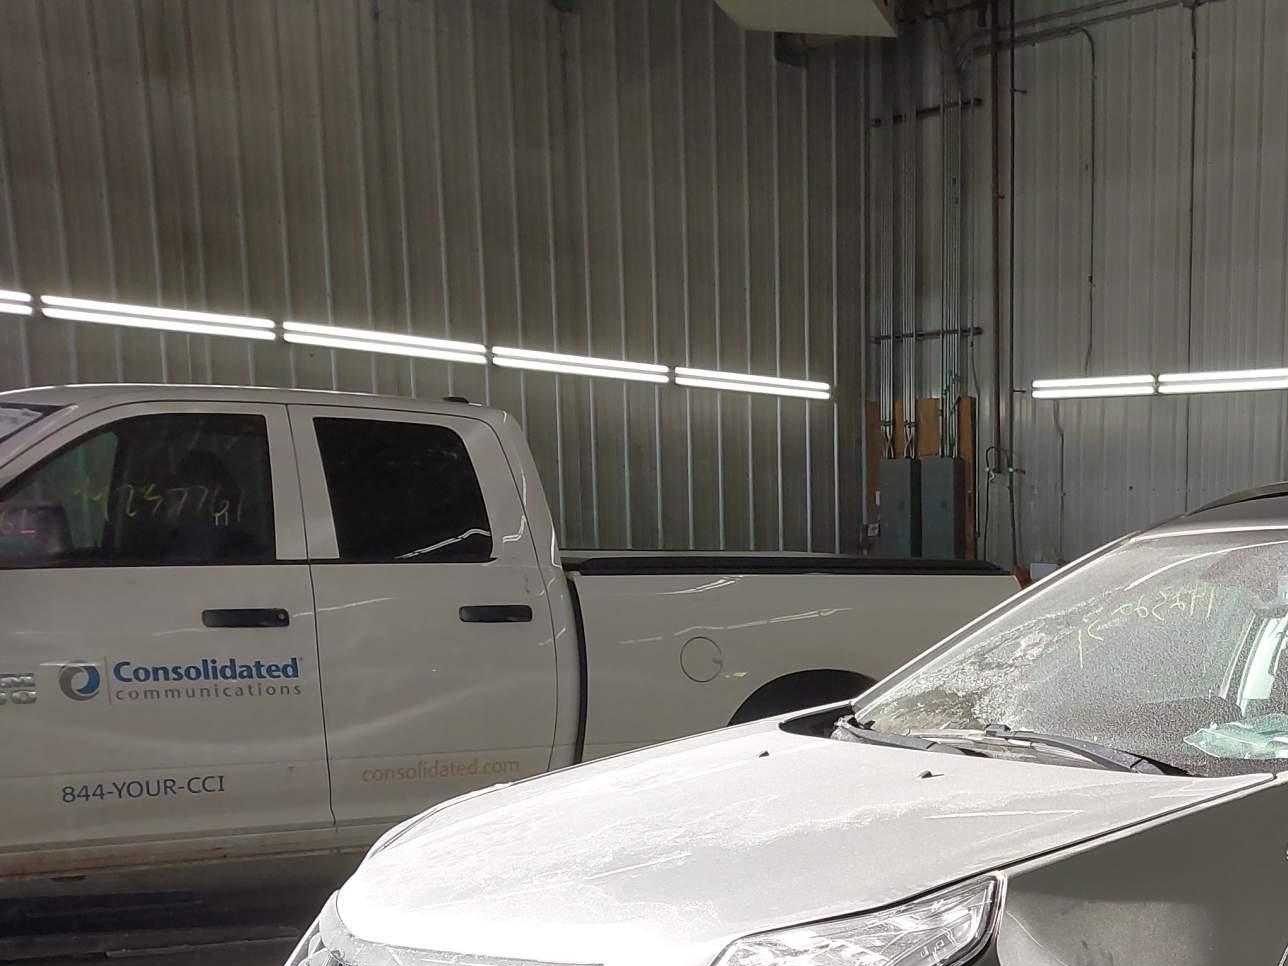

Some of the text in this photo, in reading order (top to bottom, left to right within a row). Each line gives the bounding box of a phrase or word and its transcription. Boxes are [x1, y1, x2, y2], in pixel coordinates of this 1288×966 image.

[113, 657, 299, 683] Consolidated
[115, 683, 302, 701] communications
[362, 759, 520, 784] consolidated.com
[61, 775, 225, 803] 844-YOUR-CCI
